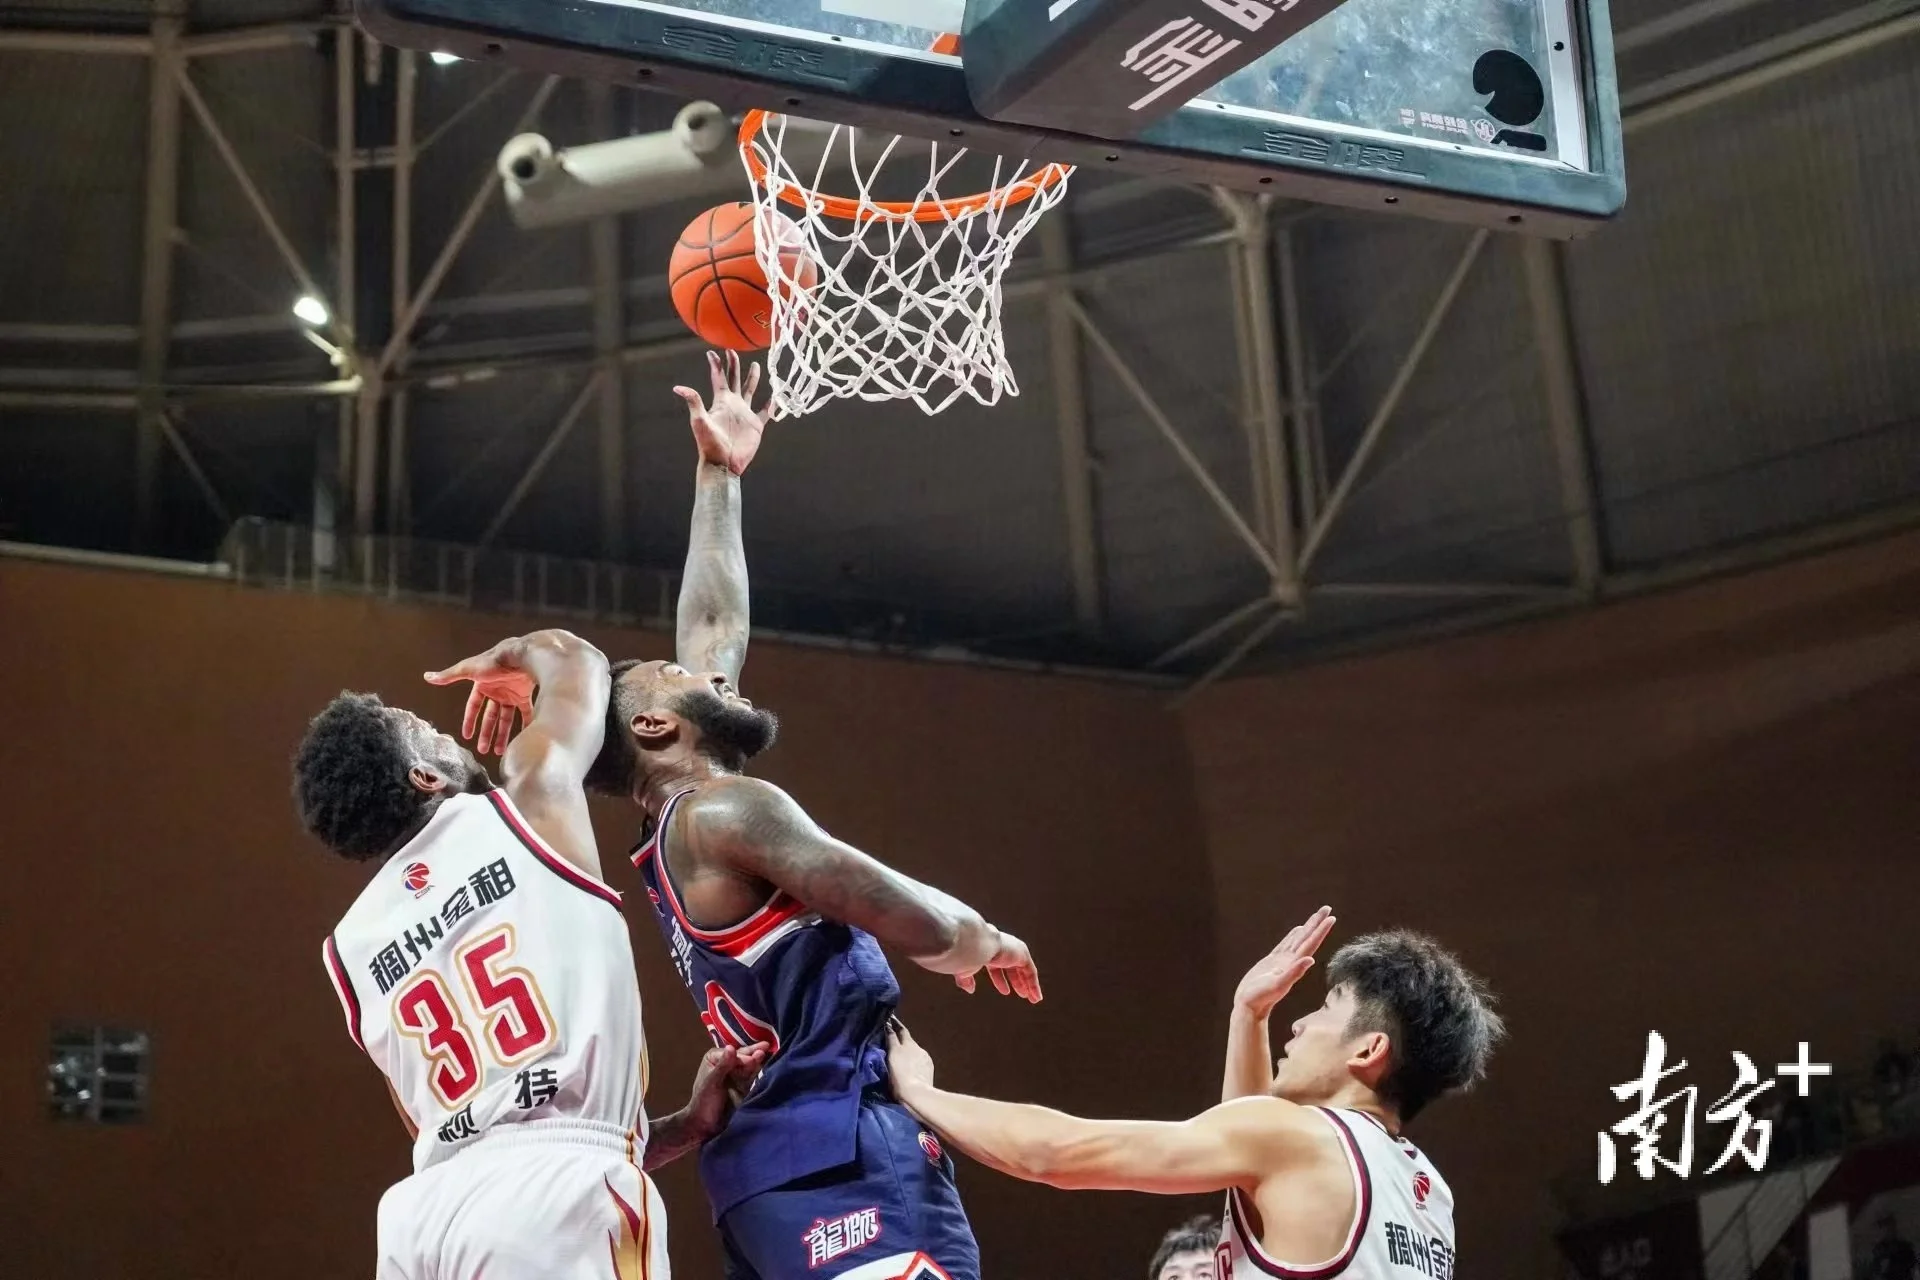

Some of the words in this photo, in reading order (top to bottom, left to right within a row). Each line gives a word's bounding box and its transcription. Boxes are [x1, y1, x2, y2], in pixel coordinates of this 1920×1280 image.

[368, 857, 516, 996] 稠州金租
[393, 922, 558, 1112] 35
